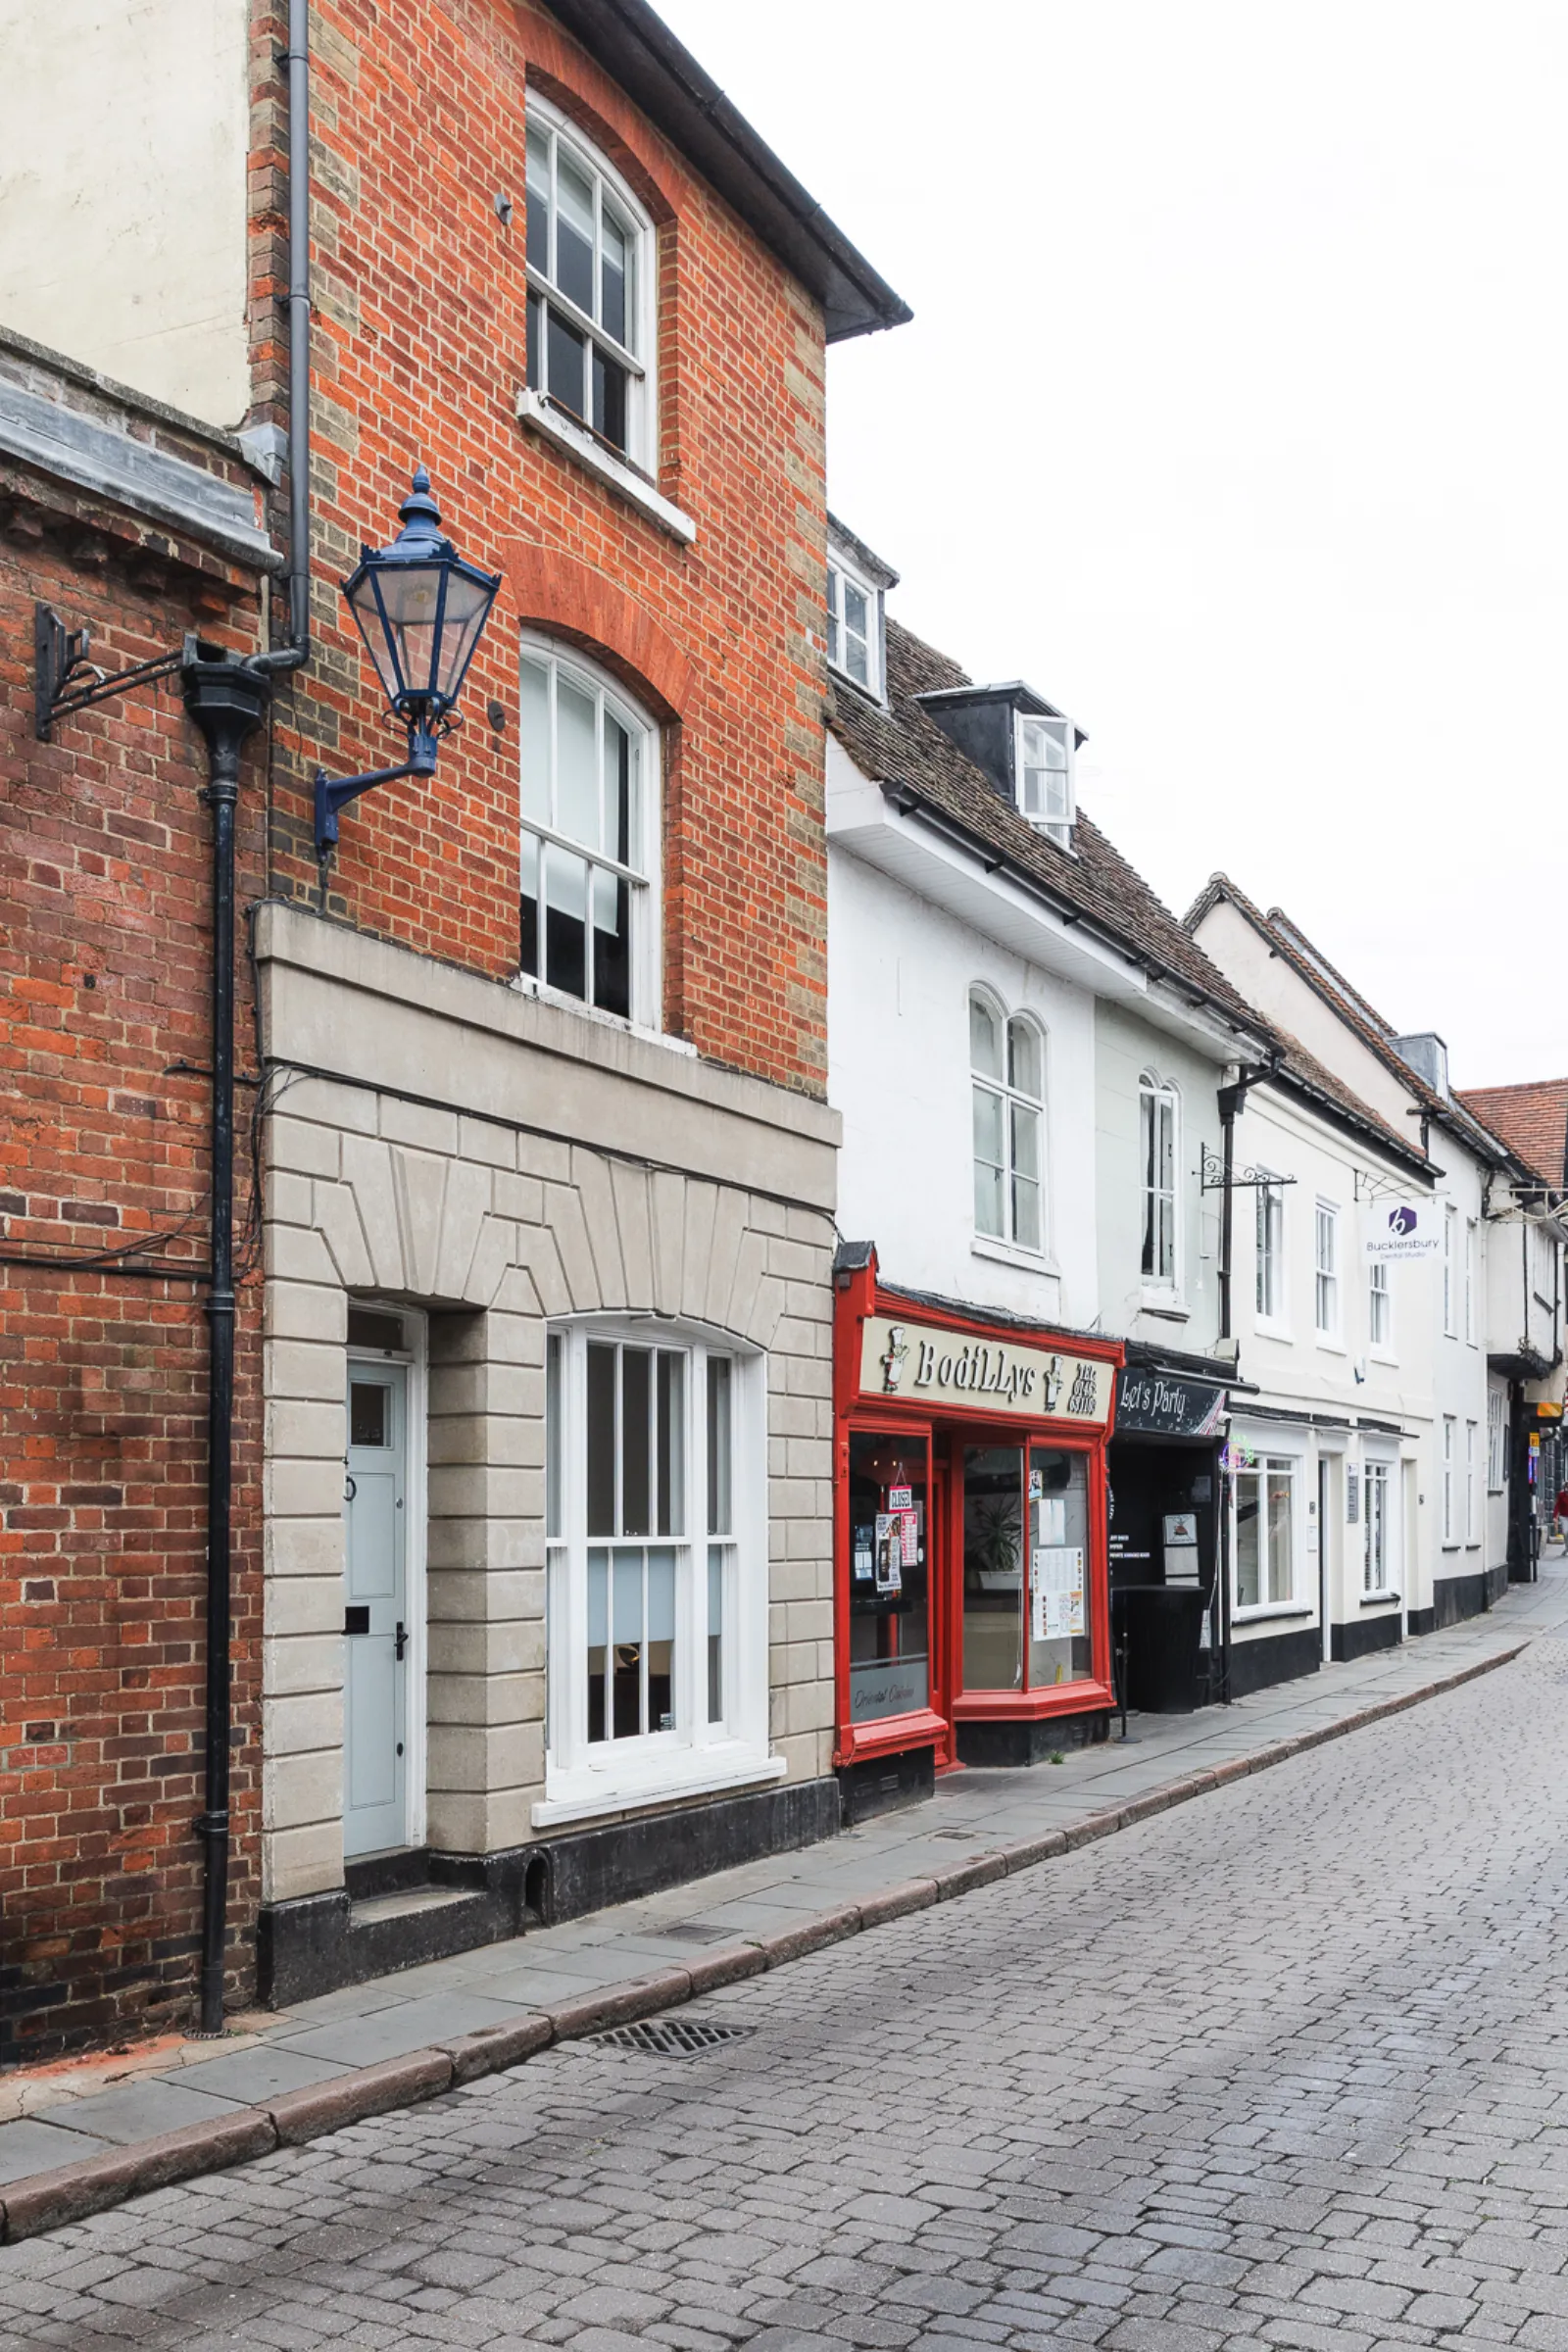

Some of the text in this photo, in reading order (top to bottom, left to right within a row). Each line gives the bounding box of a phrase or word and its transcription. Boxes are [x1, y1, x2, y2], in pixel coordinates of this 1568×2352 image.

[1366, 1240, 1439, 1251] Bucklersbury
[1120, 1375, 1186, 1423] Let's Party
[891, 1491, 910, 1508] CLOSED
